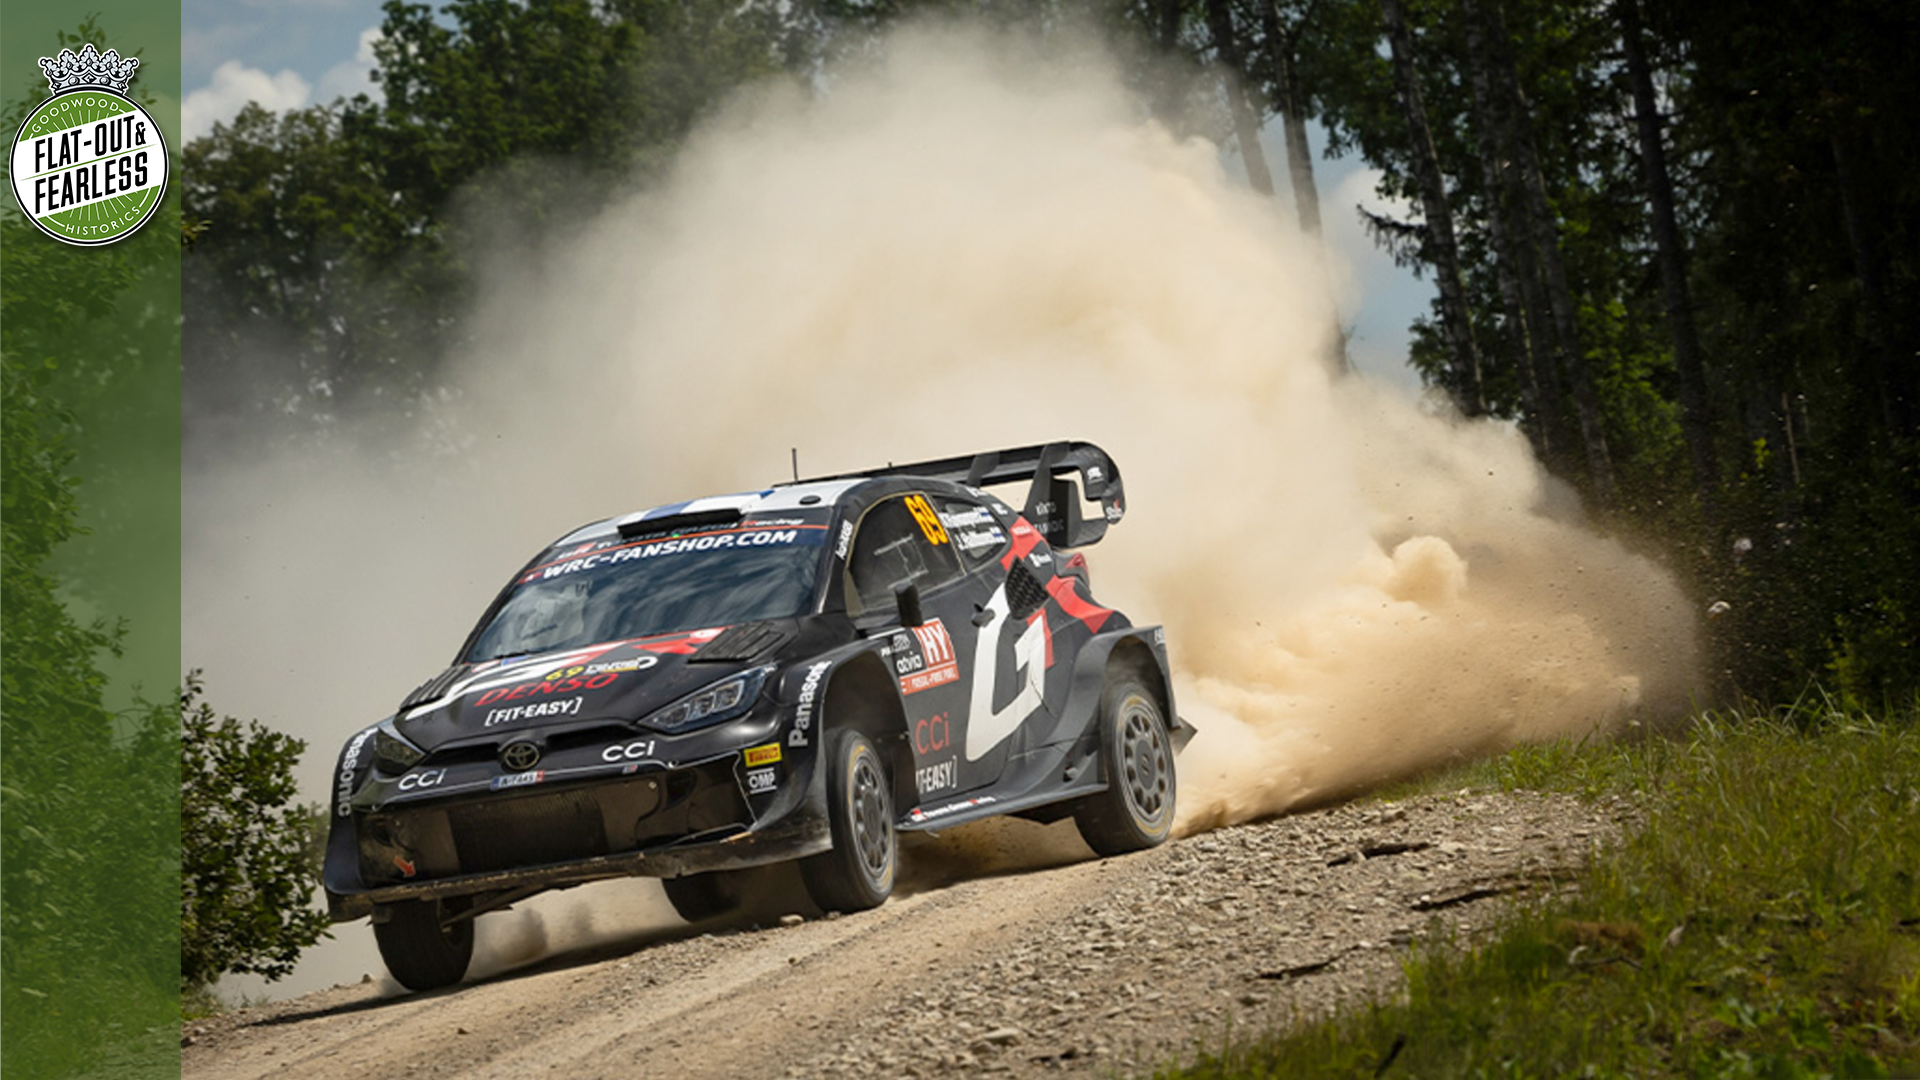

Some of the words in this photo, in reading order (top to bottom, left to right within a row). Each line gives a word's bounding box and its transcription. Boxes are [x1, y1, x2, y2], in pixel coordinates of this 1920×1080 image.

[904, 494, 949, 546] 69
[543, 529, 798, 579] WRC-FANSHOP.COM
[917, 623, 950, 664] HY
[474, 672, 619, 707] DENSO
[545, 666, 583, 681] 69
[748, 772, 776, 789] OMP
